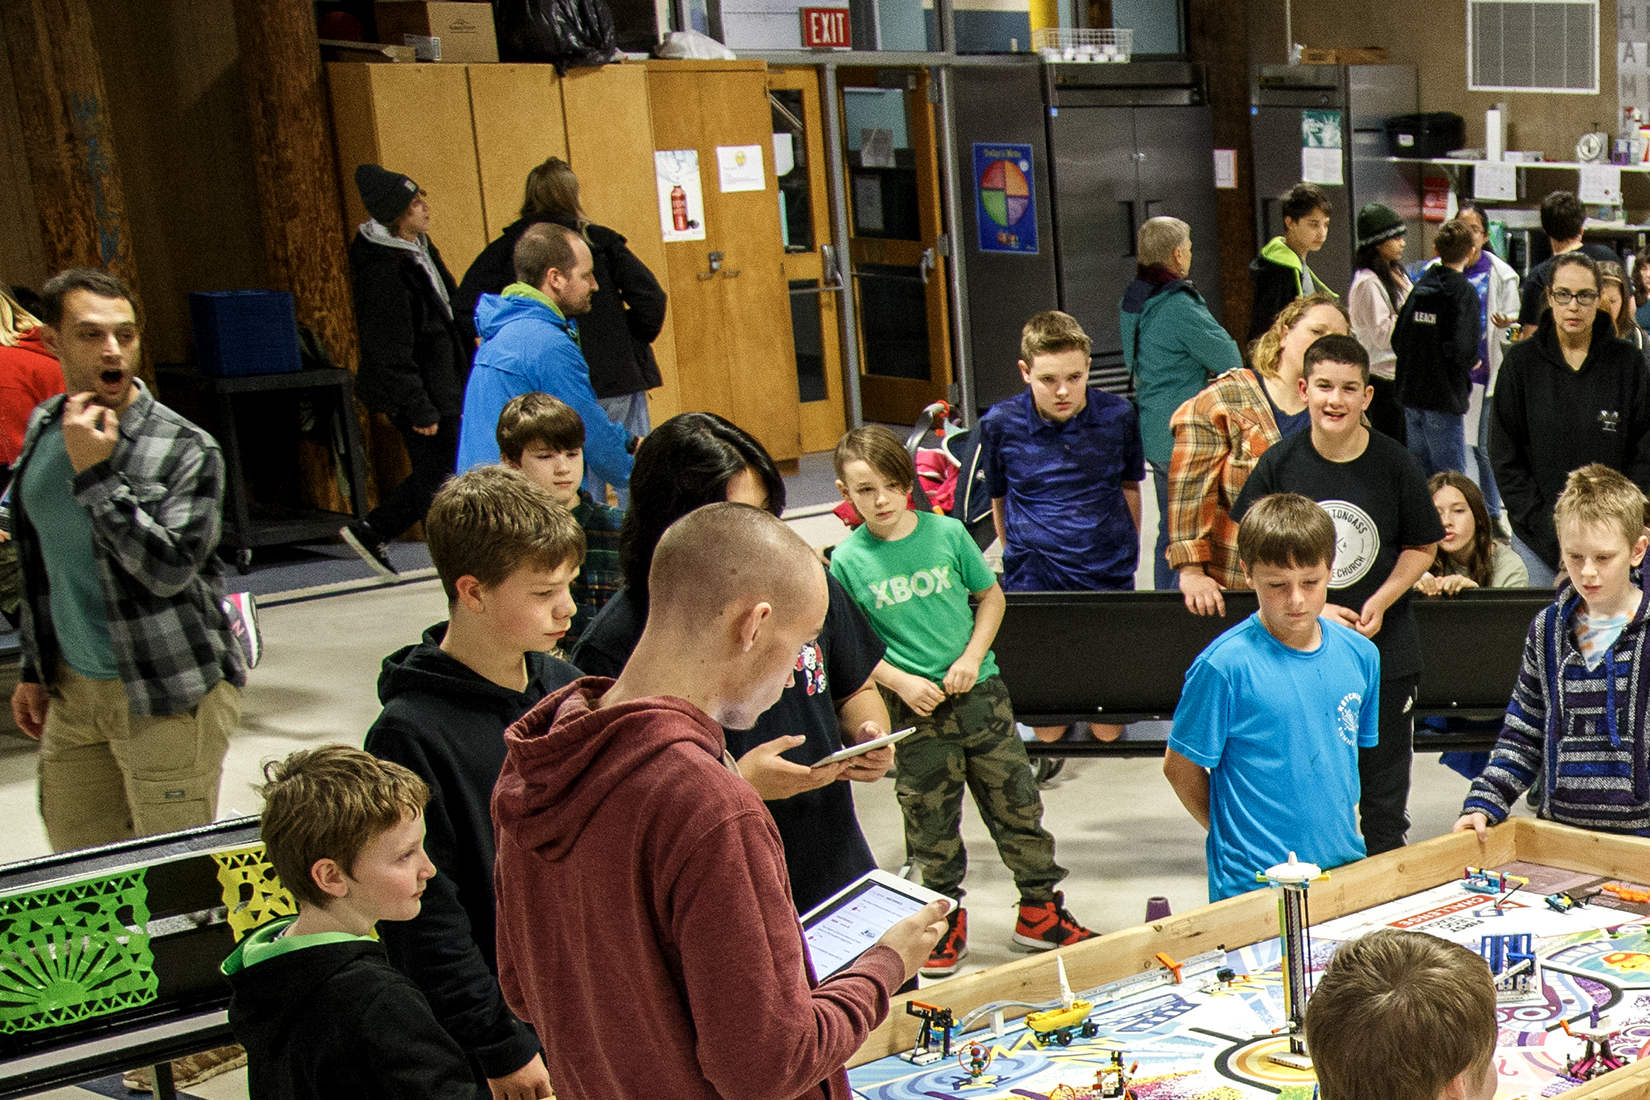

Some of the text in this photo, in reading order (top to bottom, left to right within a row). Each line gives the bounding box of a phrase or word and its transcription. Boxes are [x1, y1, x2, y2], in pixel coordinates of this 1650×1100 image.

[810, 12, 845, 44] EXIT
[1332, 509, 1368, 535] TONGASS
[1337, 556, 1366, 577] CHURCH
[868, 565, 952, 610] XBOX
[1399, 897, 1485, 926] CHALLENGE
[1440, 917, 1475, 929] LEGO
[1450, 920, 1485, 933] FIRST
